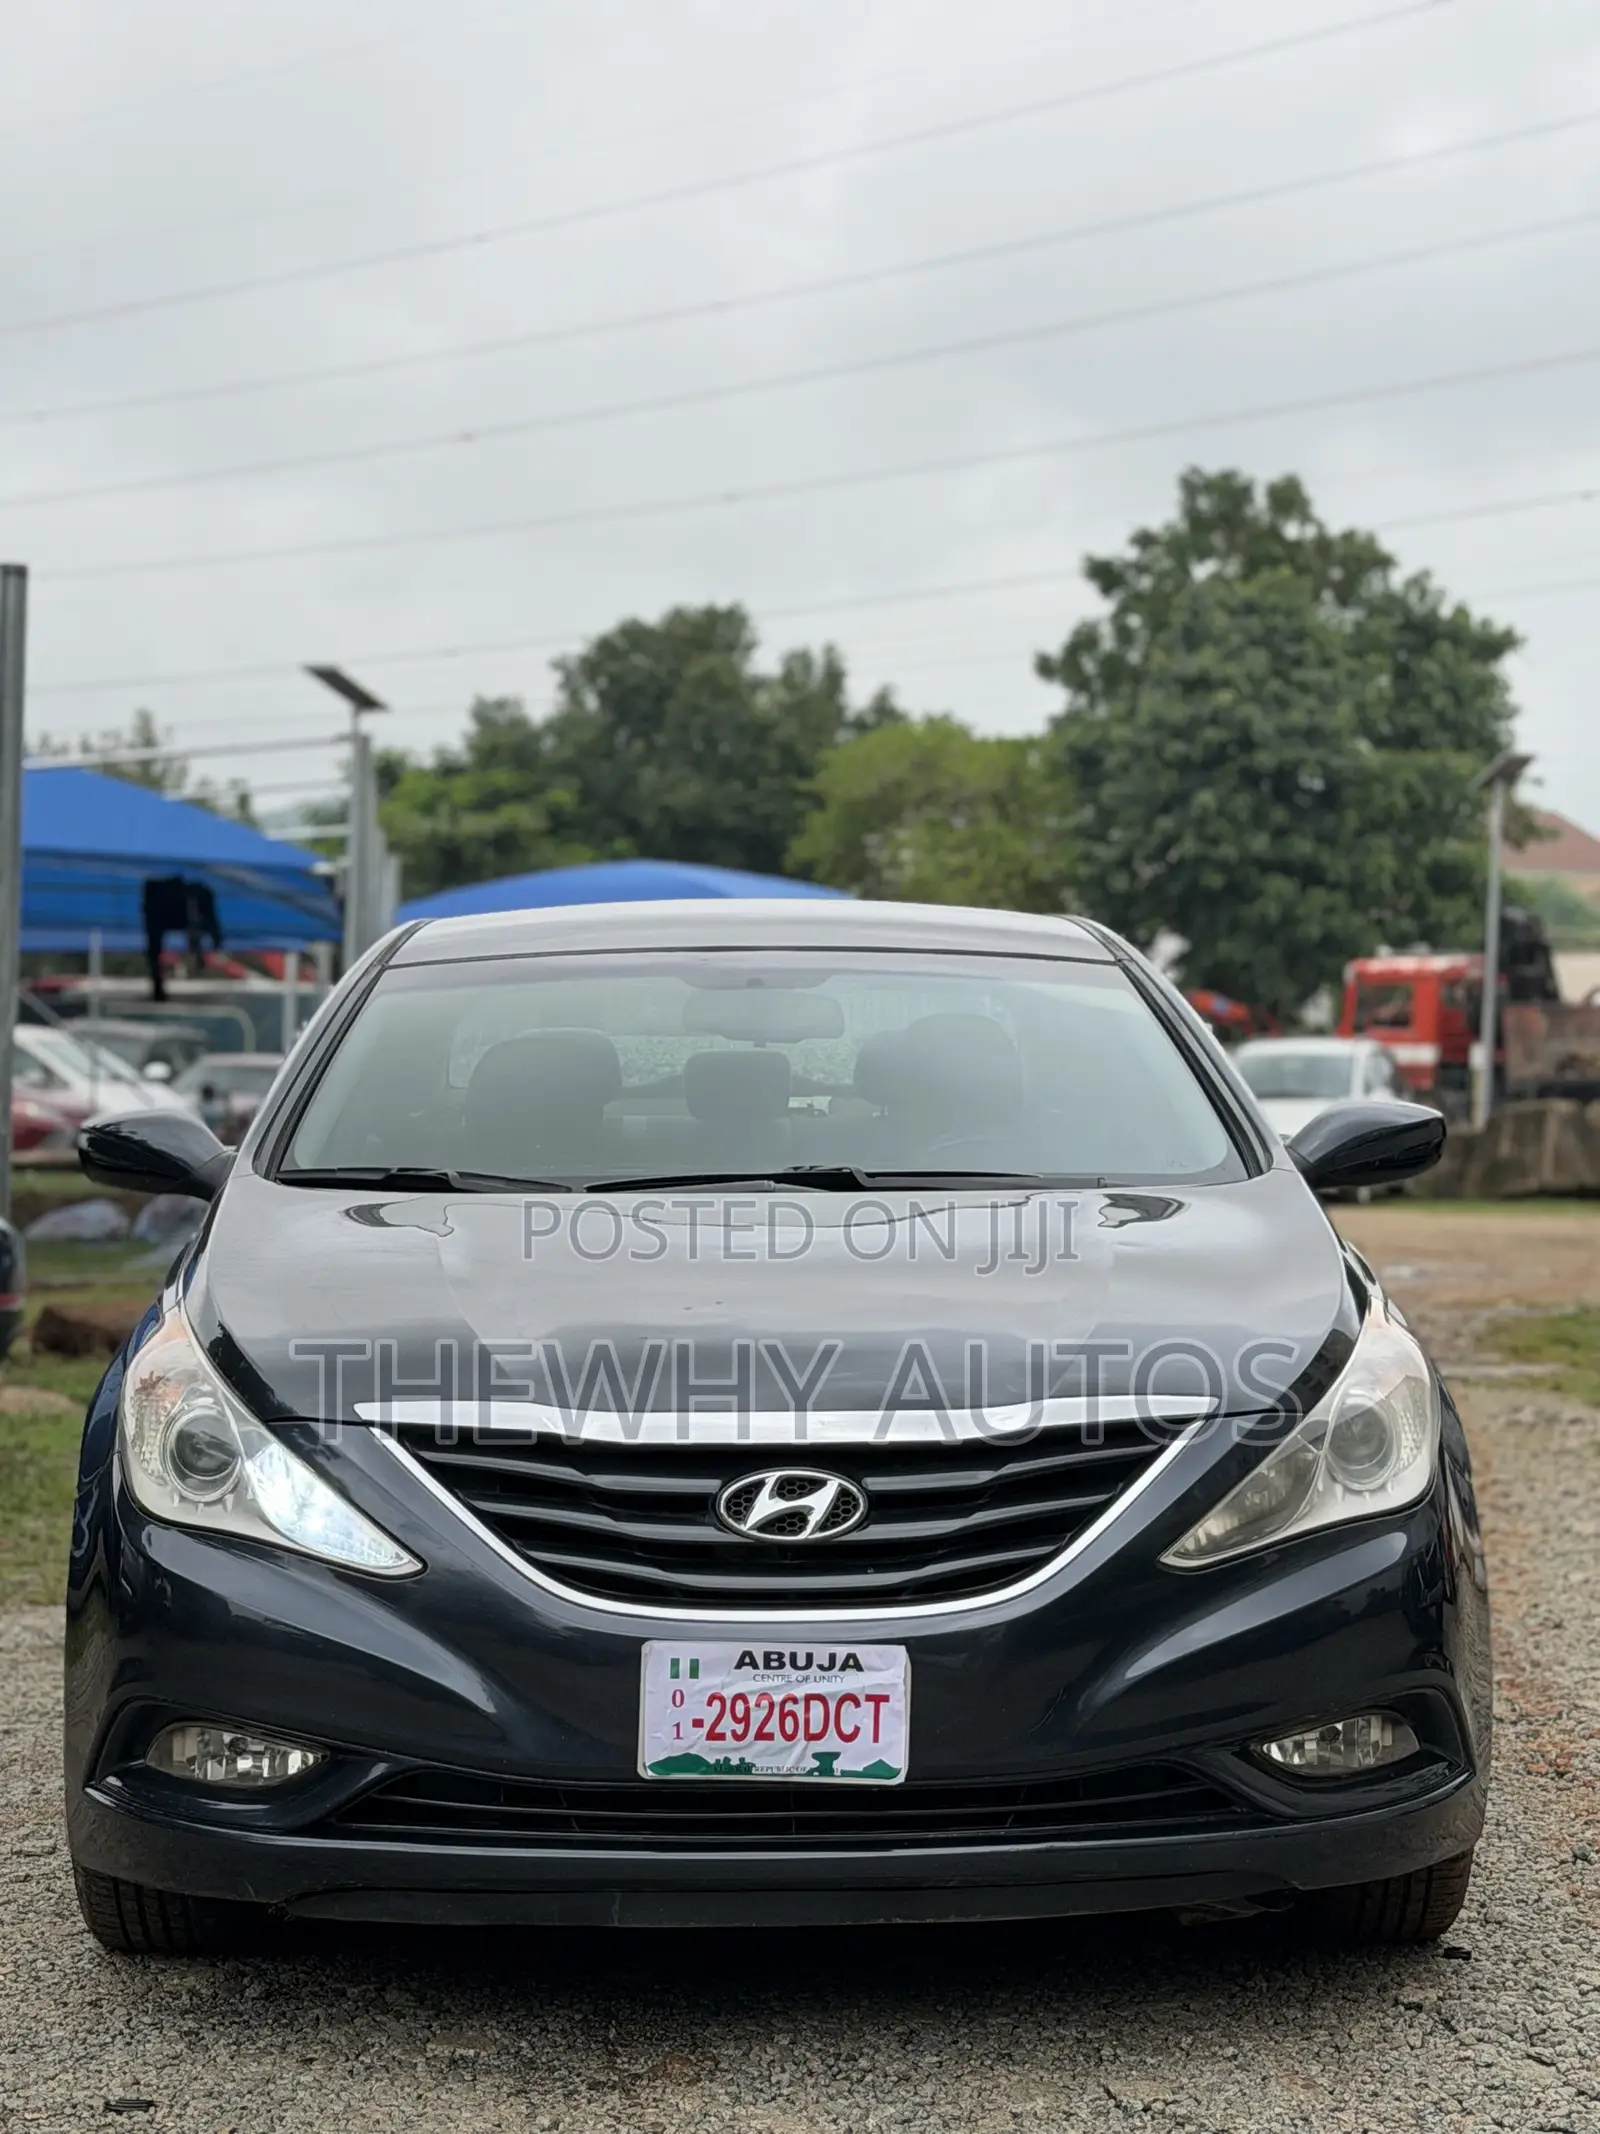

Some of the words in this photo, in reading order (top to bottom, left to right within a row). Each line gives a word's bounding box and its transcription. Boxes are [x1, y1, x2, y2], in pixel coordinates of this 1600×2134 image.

[734, 1650, 864, 1672] ABUJA
[753, 1673, 792, 1683] CENTRE
[795, 1674, 810, 1683] OF
[814, 1675, 845, 1684] UNITY
